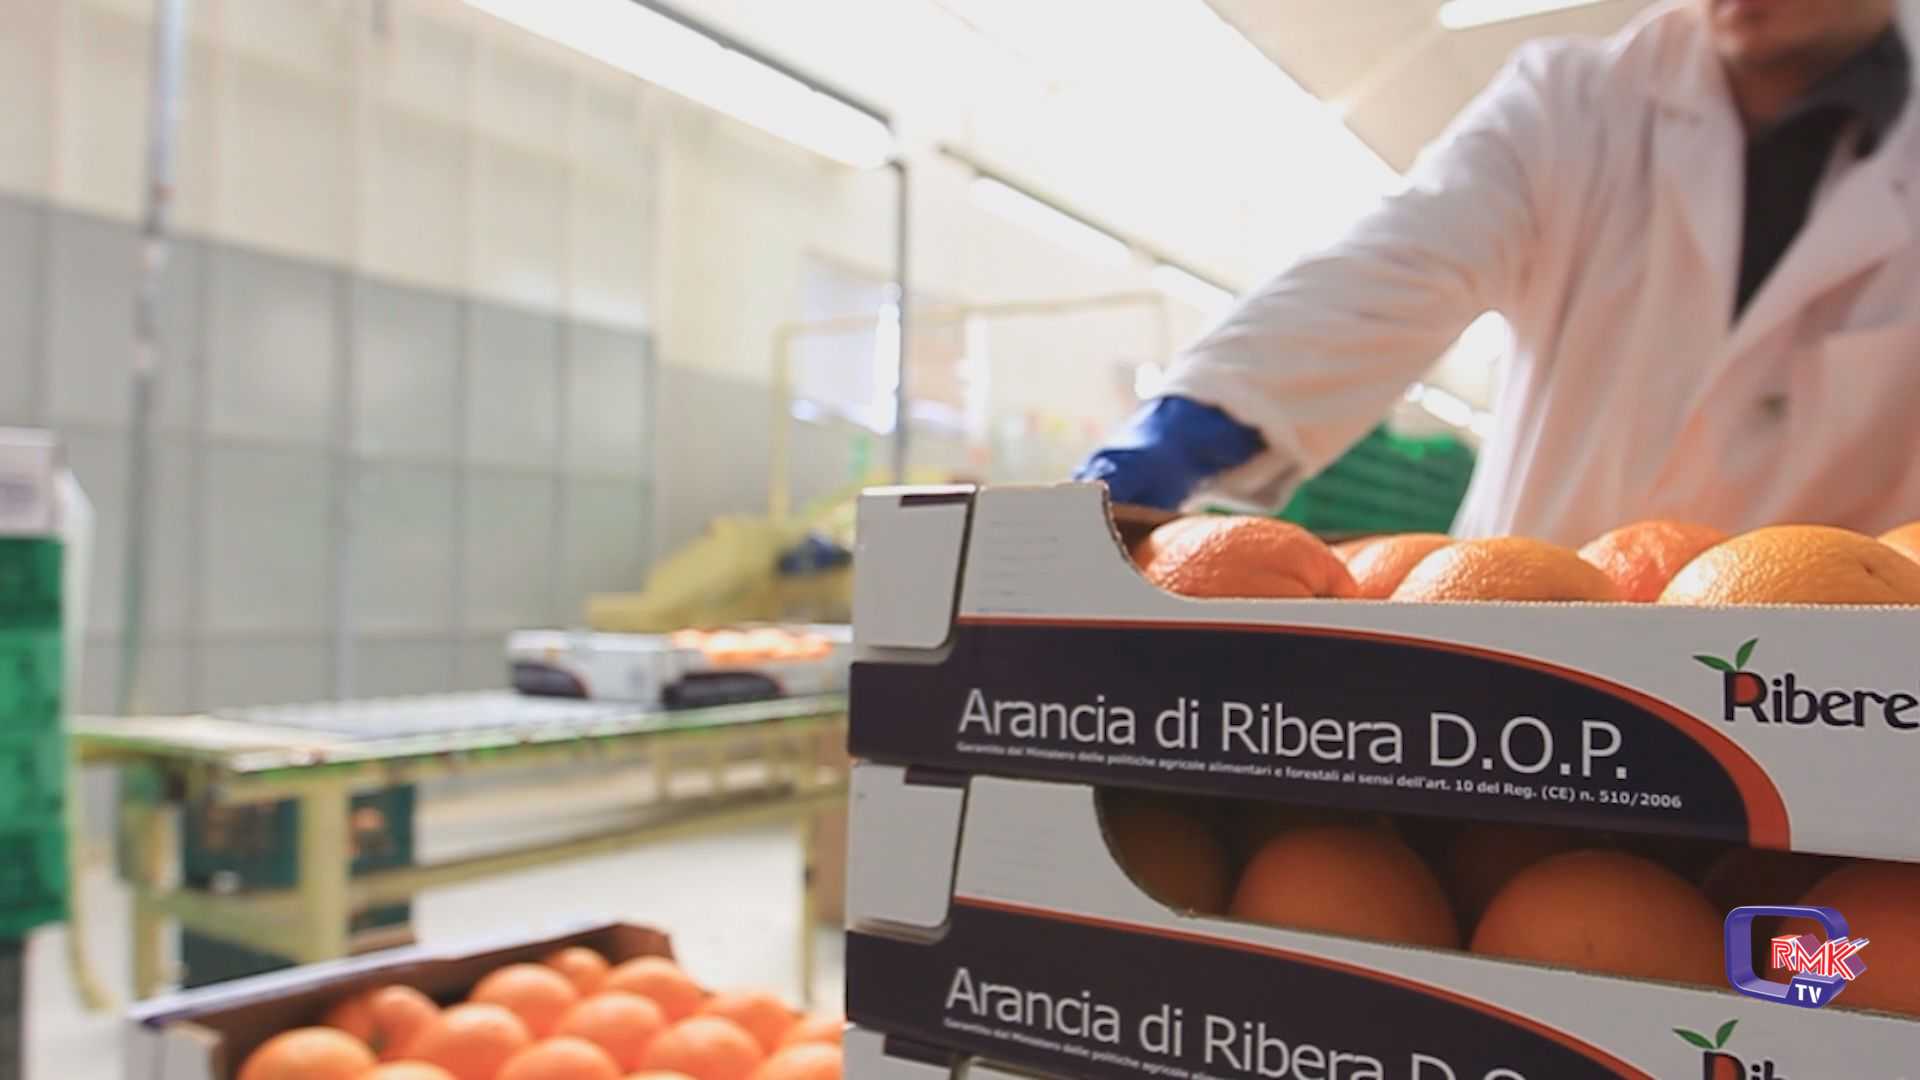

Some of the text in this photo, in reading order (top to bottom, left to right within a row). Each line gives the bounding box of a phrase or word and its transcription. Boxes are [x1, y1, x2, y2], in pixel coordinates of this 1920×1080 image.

[958, 687, 1628, 780] Arancia di Ribera D.O.P.
[1722, 670, 1920, 730] Ribere
[1107, 754, 1156, 767] politiche
[1158, 757, 1206, 771] agricole
[1208, 760, 1272, 776] alimentari
[1274, 767, 1283, 778] e
[1285, 766, 1340, 782] forestali
[1342, 771, 1355, 783] ai
[1358, 772, 1394, 786] sensi
[1396, 775, 1451, 791] dell'art.
[1456, 779, 1474, 793] 10
[1477, 780, 1500, 795] del
[1503, 783, 1537, 799] Reg.
[1541, 786, 1576, 802] (CE)
[1579, 790, 1595, 803] n.
[1599, 790, 1683, 809] 510/2006
[945, 966, 1121, 1044] Arancia
[1138, 1003, 1184, 1057] di
